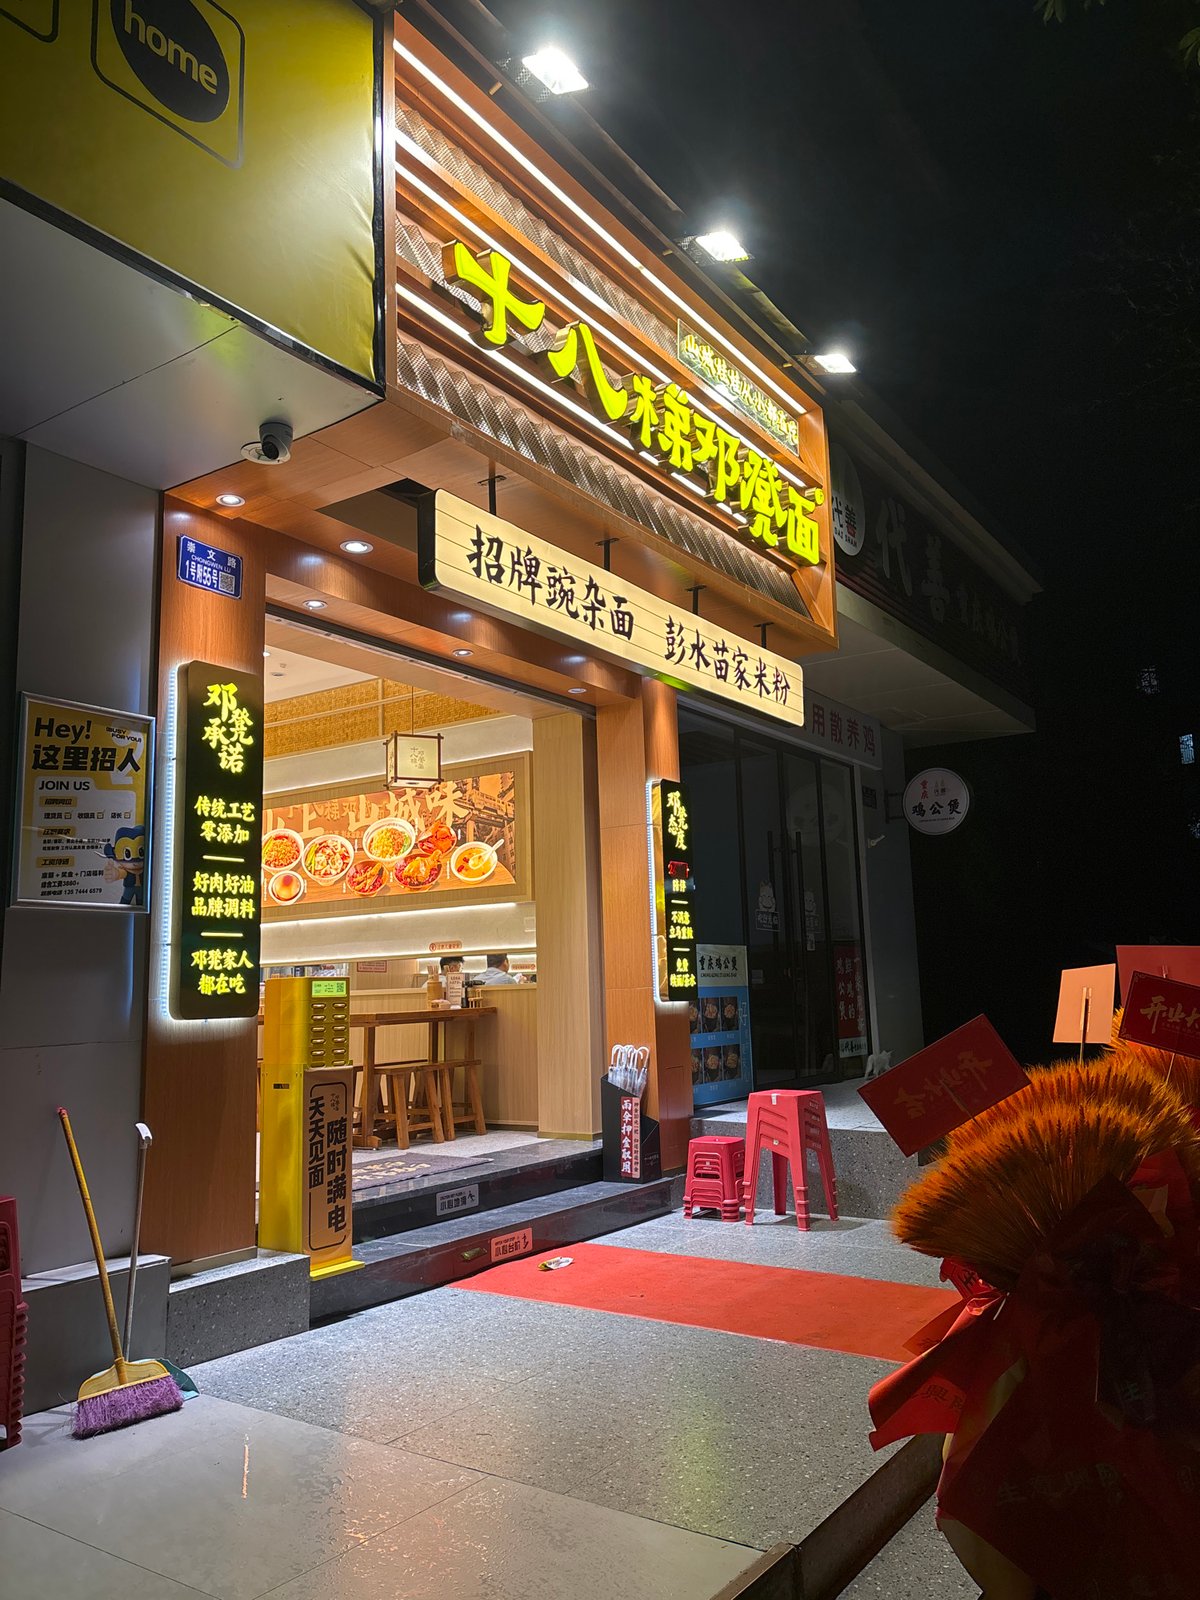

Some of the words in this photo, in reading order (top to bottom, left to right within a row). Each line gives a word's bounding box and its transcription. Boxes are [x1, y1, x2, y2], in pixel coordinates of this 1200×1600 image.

[124, 0, 218, 94] home
[466, 524, 634, 640] 招牌豌杂面
[664, 615, 791, 706] 彭水苗家米粉
[34, 717, 92, 744] Hey!
[804, 704, 875, 755] 用散养鸡
[32, 744, 140, 773] 这里招人
[39, 780, 69, 791] JOIN
[73, 780, 90, 791] US
[194, 795, 255, 822] 传统工艺
[912, 798, 961, 818] 鸡公煲
[200, 820, 250, 844] 零添加
[193, 871, 255, 894] 好肉好油
[191, 896, 255, 919] 品牌调料
[198, 973, 246, 995] 都在吃
[308, 1096, 324, 1190] 天天见面
[621, 1099, 632, 1174] 雨伞押金取用
[327, 1117, 347, 1233] 随时满电
